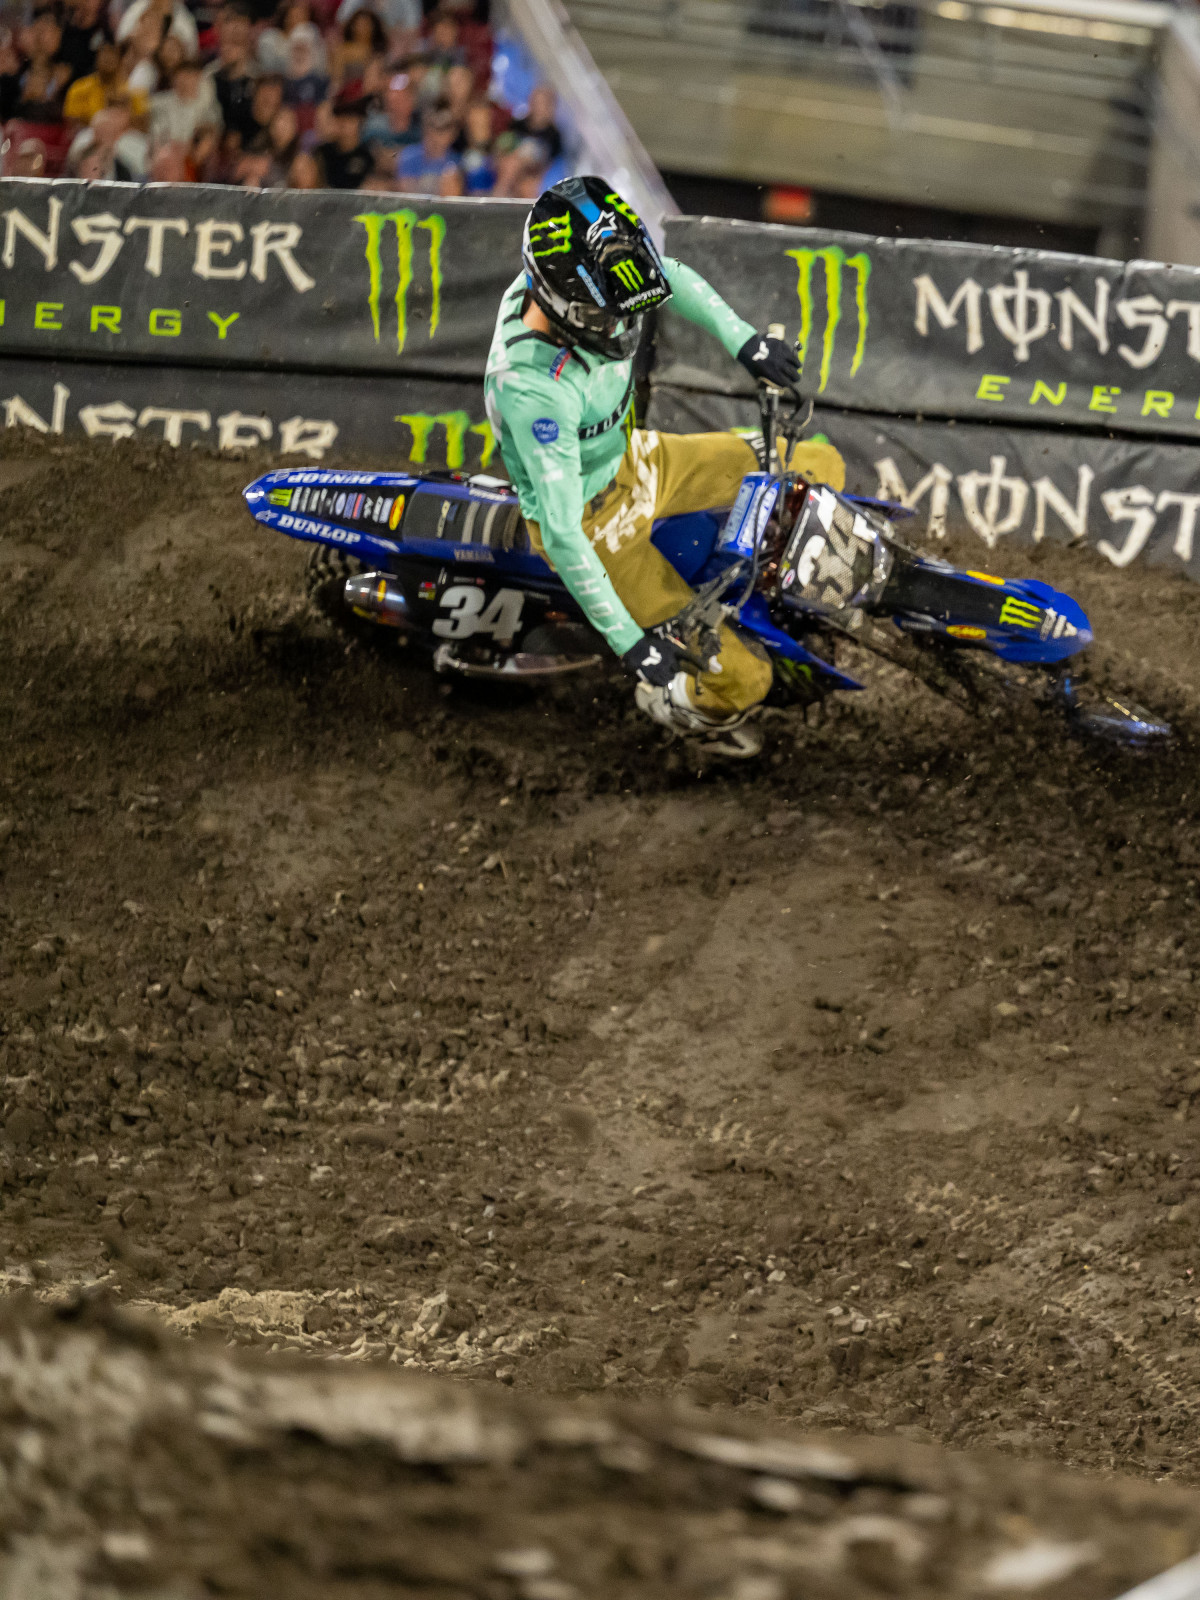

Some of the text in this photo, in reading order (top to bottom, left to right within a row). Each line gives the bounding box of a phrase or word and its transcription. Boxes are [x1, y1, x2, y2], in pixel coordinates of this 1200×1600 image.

[3, 196, 316, 292] NSTER
[0, 300, 240, 340] ERGY
[287, 472, 377, 486] DUNLOP
[276, 513, 362, 544] DUNLOP
[431, 585, 526, 645] 34
